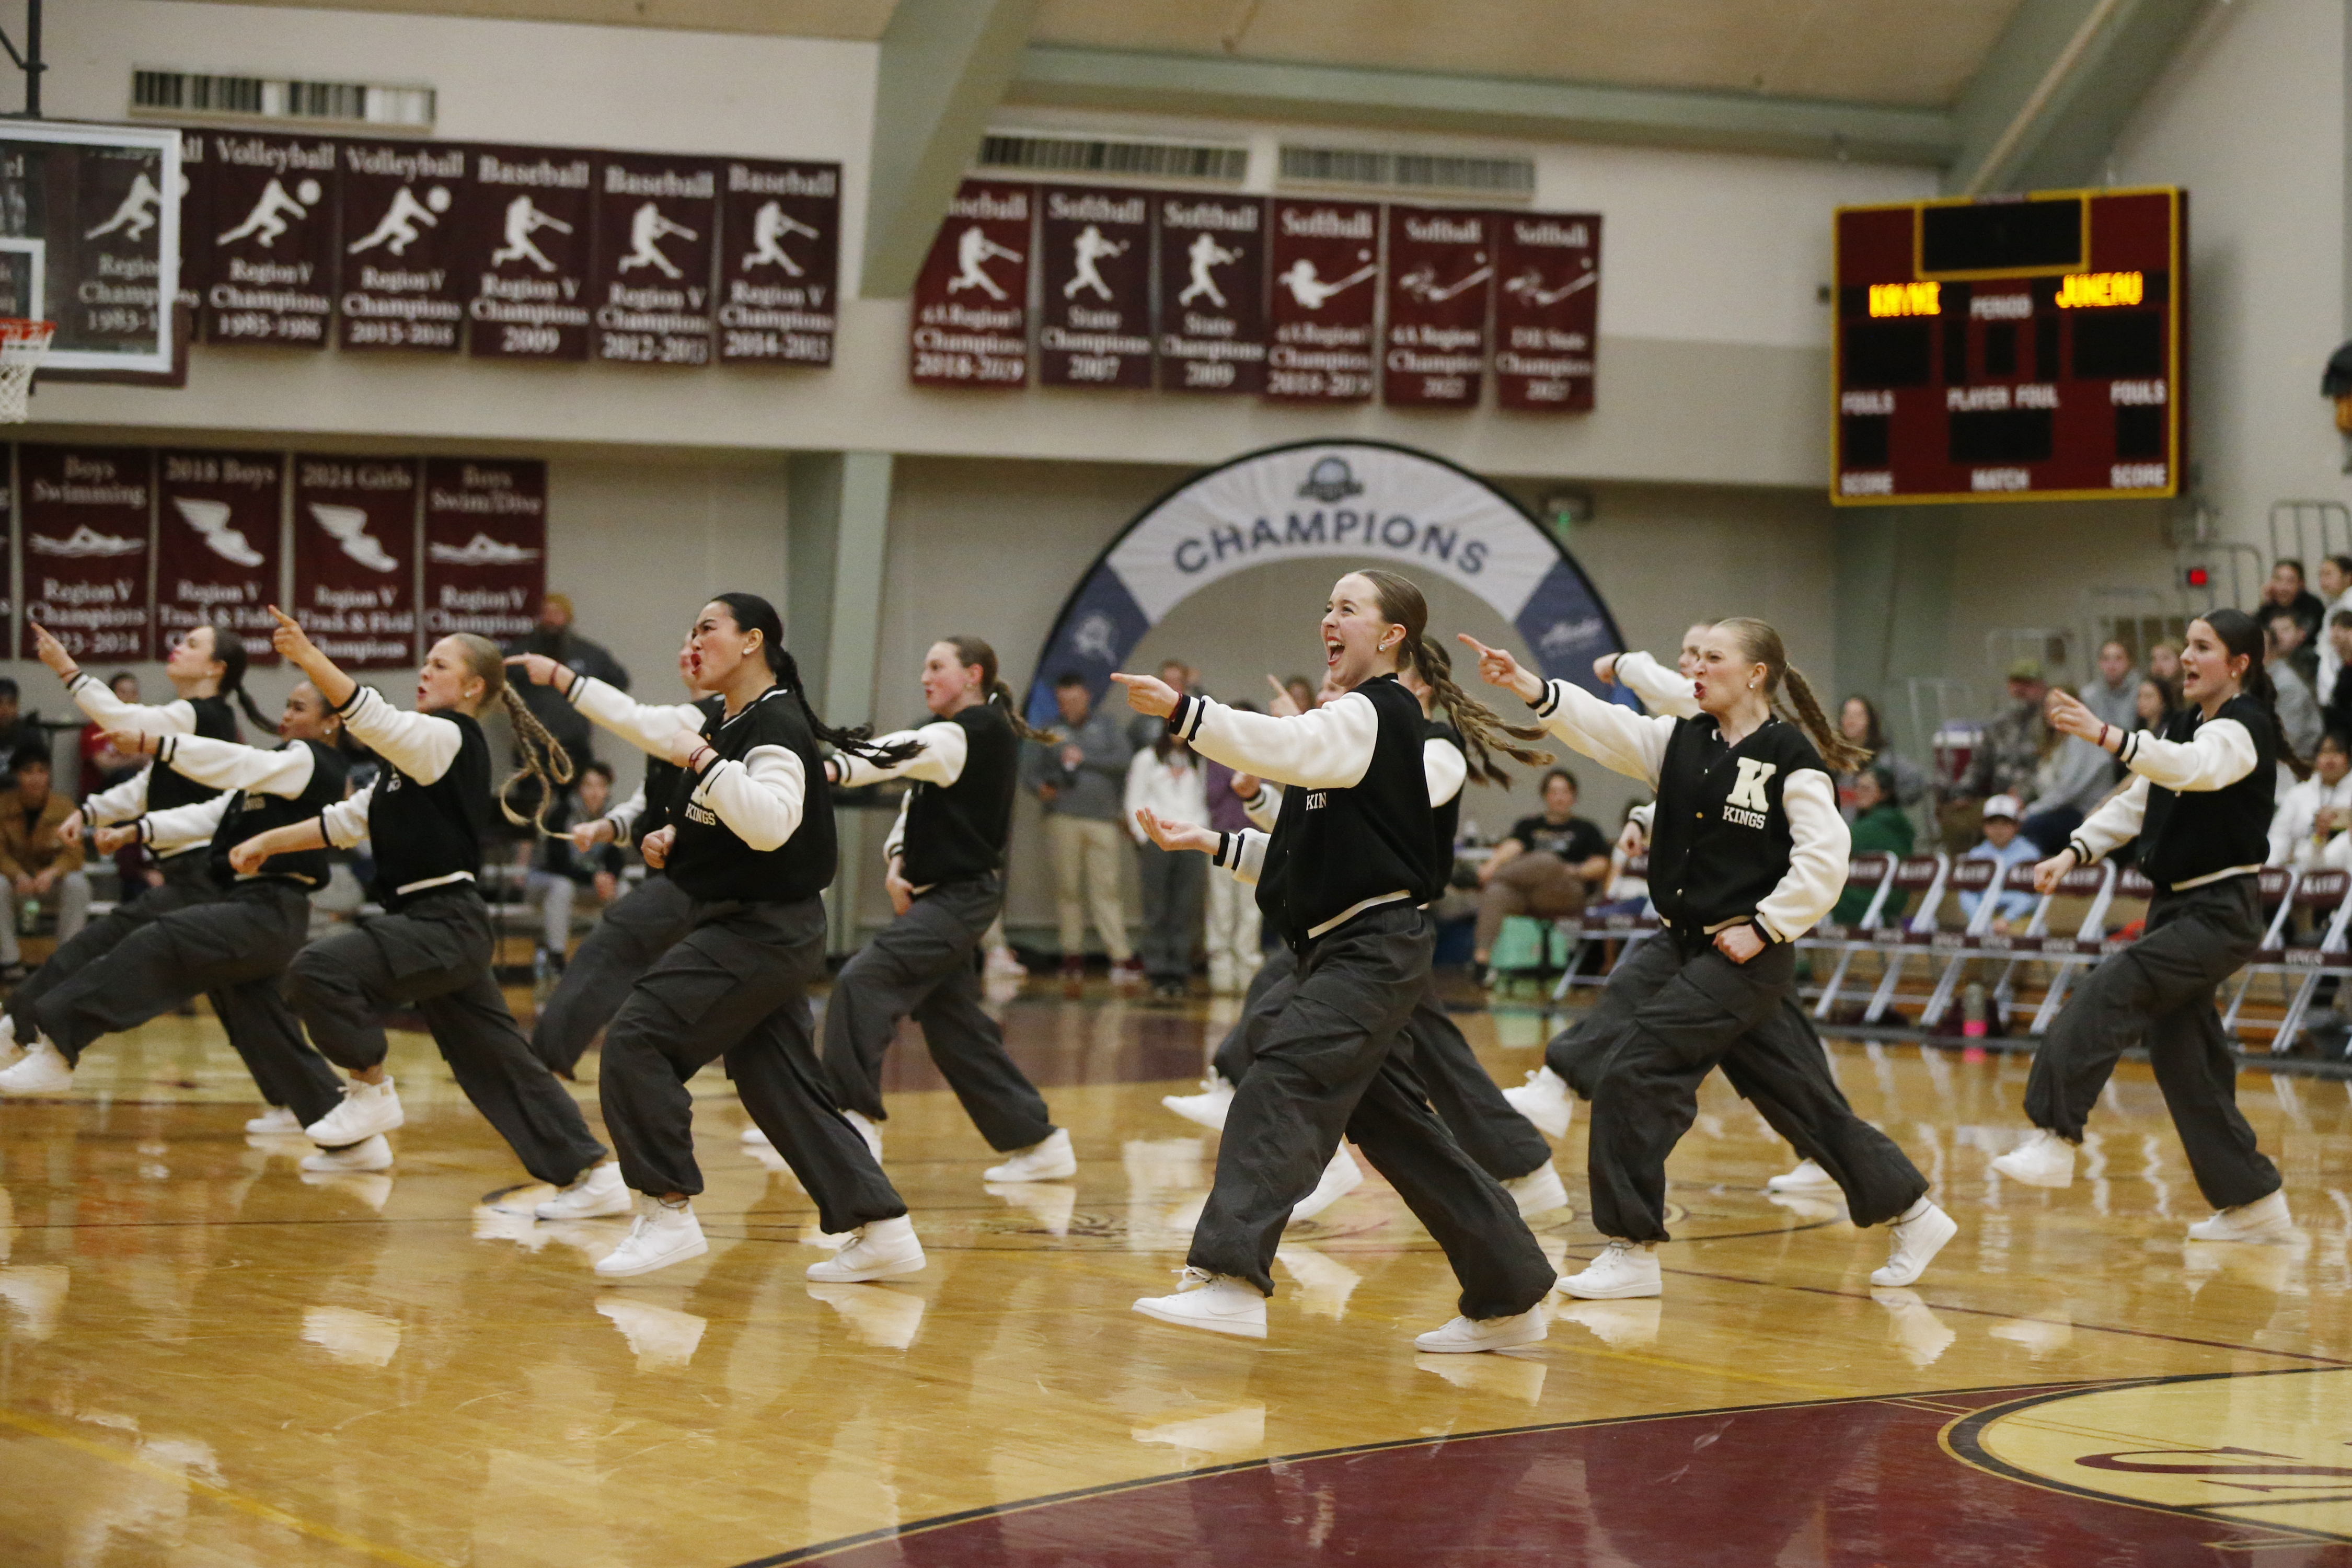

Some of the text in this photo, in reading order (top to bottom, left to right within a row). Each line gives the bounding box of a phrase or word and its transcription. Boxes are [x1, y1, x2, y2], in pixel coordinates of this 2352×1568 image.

[216, 137, 336, 174] Volleyball
[346, 145, 465, 183] Volleyball
[478, 155, 590, 189] Baseball
[605, 164, 715, 199] Baseball
[728, 163, 836, 198] Baseball
[1048, 192, 1145, 225] Softball
[1163, 200, 1259, 232] Softball
[1282, 207, 1373, 240] Softball
[1404, 216, 1483, 244] Softball
[1514, 220, 1588, 248] Softball
[230, 258, 296, 285] Region
[361, 266, 429, 293] Region
[78, 281, 201, 308] Champns
[210, 284, 330, 315] Champions
[481, 272, 559, 302] Region
[609, 281, 685, 312] Region
[732, 279, 805, 308] Region
[341, 292, 462, 321] Champions
[469, 297, 590, 328] Champions
[596, 304, 711, 336] Champions
[719, 303, 835, 333] Champions
[1969, 293, 2033, 320] PERIOD
[1041, 325, 1151, 355] Champions
[1158, 333, 1266, 362] Champions
[1267, 344, 1374, 372] Champion
[1841, 390, 1895, 416] FOULS
[1947, 383, 2060, 412] PLAYER FOUL
[2110, 378, 2167, 407] FOULS
[222, 456, 276, 491] Boys
[2111, 463, 2167, 489] SCORE
[1174, 509, 1489, 574] CHAMPIONS
[43, 578, 114, 606] Region
[177, 580, 243, 605] Region
[317, 583, 377, 610] Region
[440, 583, 509, 610] Region
[27, 602, 147, 630] Champions
[422, 607, 534, 635] Champion
[1726, 756, 1777, 812] K
[685, 802, 717, 826] KINGS
[1306, 791, 1327, 811] KIN
[1722, 805, 1766, 829] KINGS
